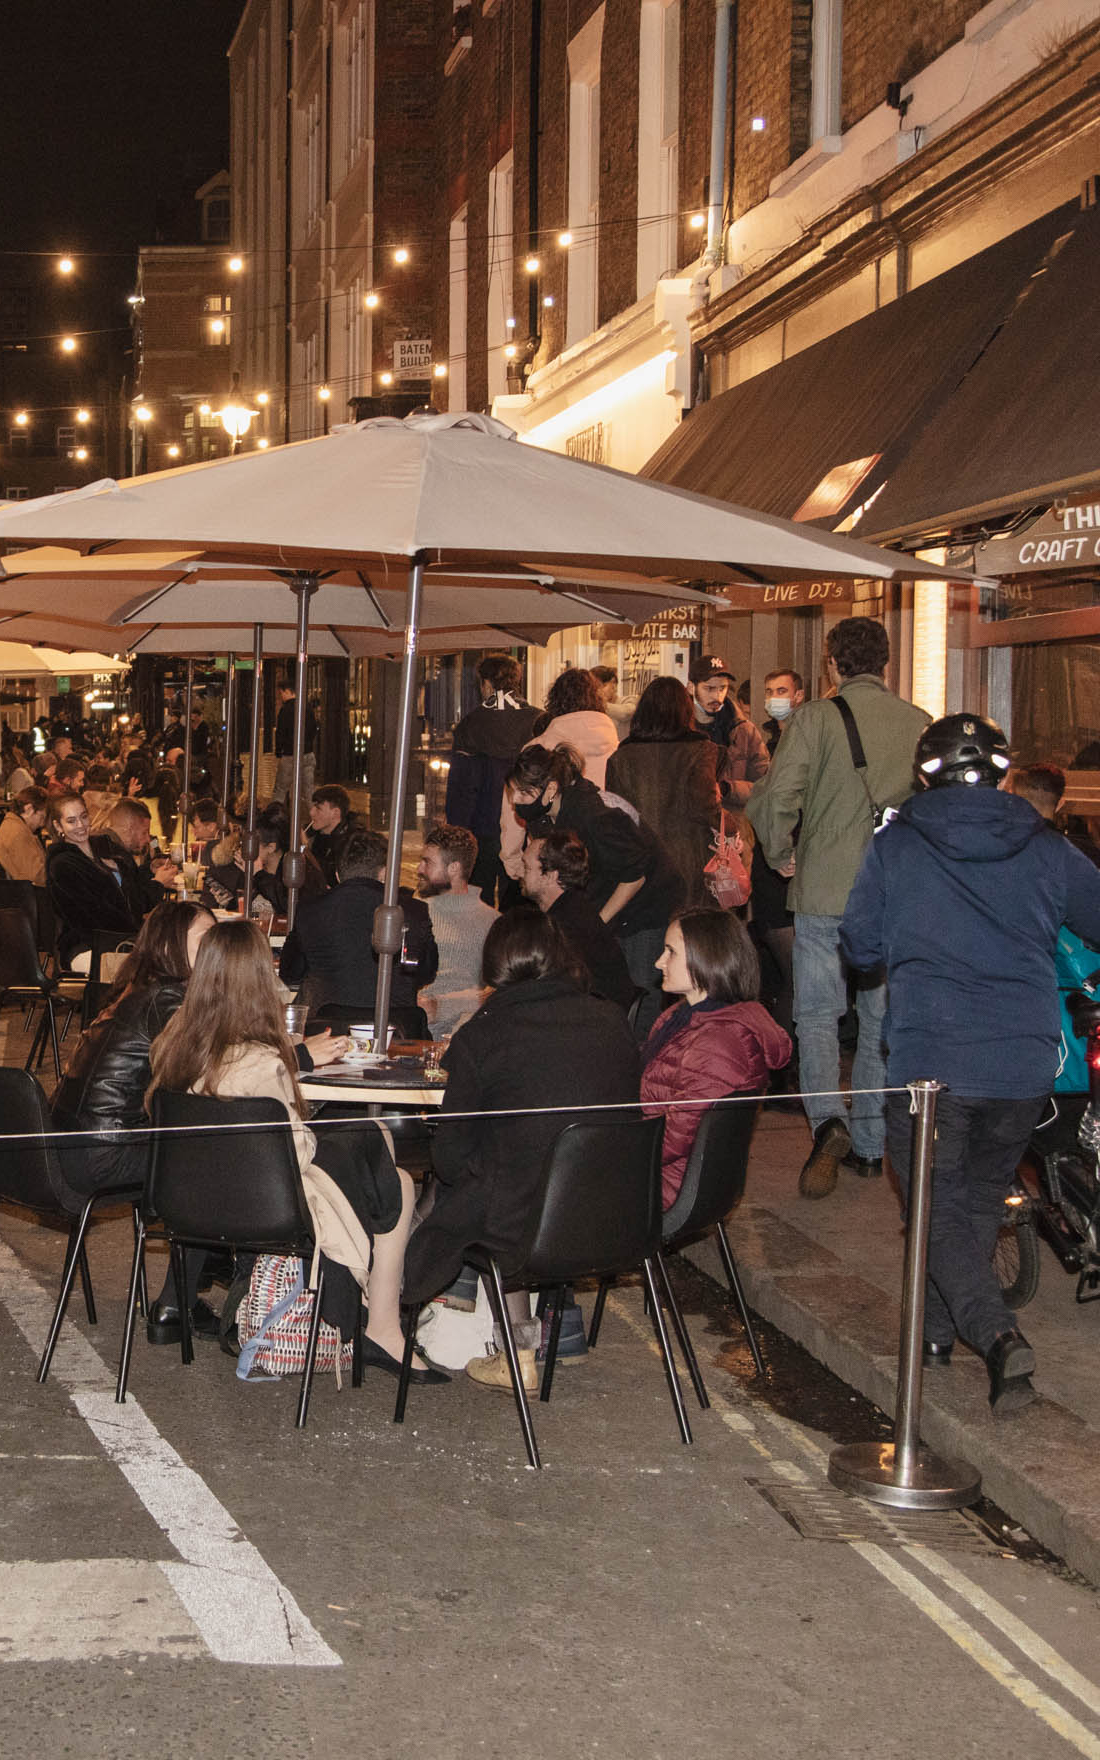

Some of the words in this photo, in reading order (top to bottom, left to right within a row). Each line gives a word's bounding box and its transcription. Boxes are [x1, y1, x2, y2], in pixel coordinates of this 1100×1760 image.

[1019, 537, 1088, 564] CRAFT
[763, 584, 799, 603] LIVE
[631, 622, 668, 638] LATE
[672, 625, 697, 639] BAR
[93, 673, 112, 682] PIX
